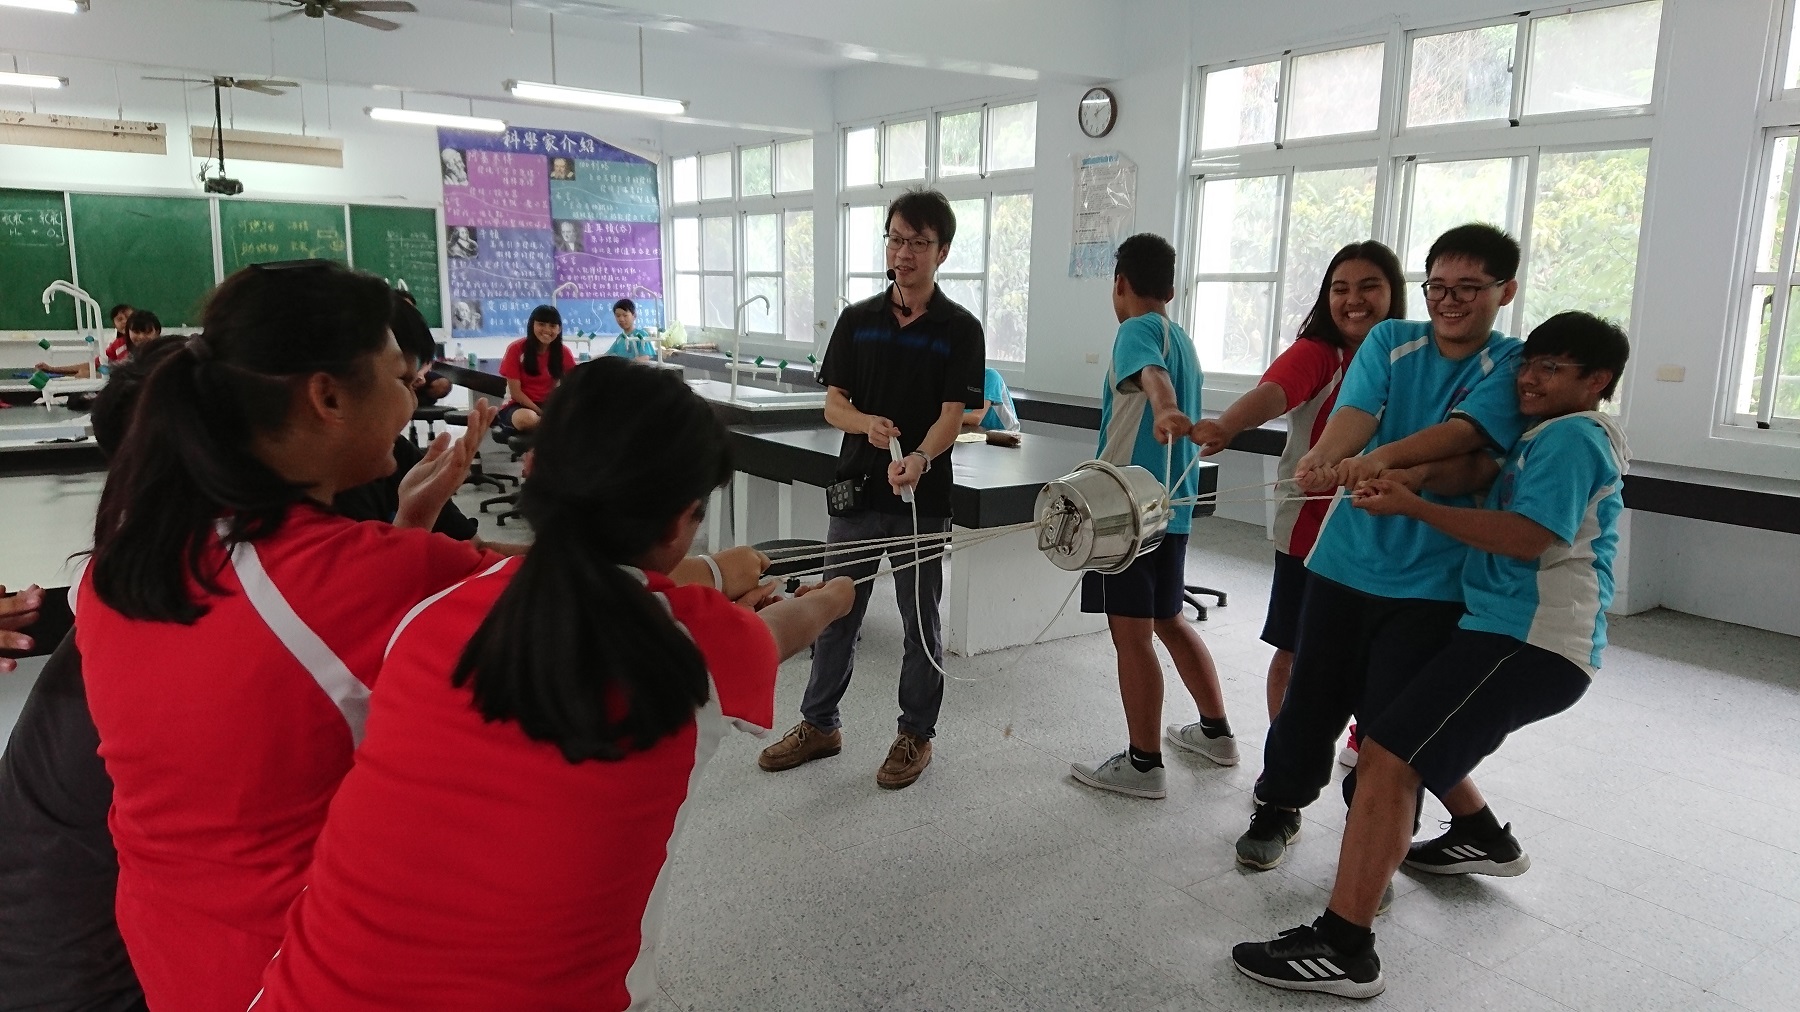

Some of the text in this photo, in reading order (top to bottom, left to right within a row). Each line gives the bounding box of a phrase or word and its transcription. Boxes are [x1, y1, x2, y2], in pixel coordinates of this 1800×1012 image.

[503, 129, 595, 153] 科學家介紹
[479, 229, 500, 241] 牛頓
[487, 300, 531, 312] 愛因斯坦
